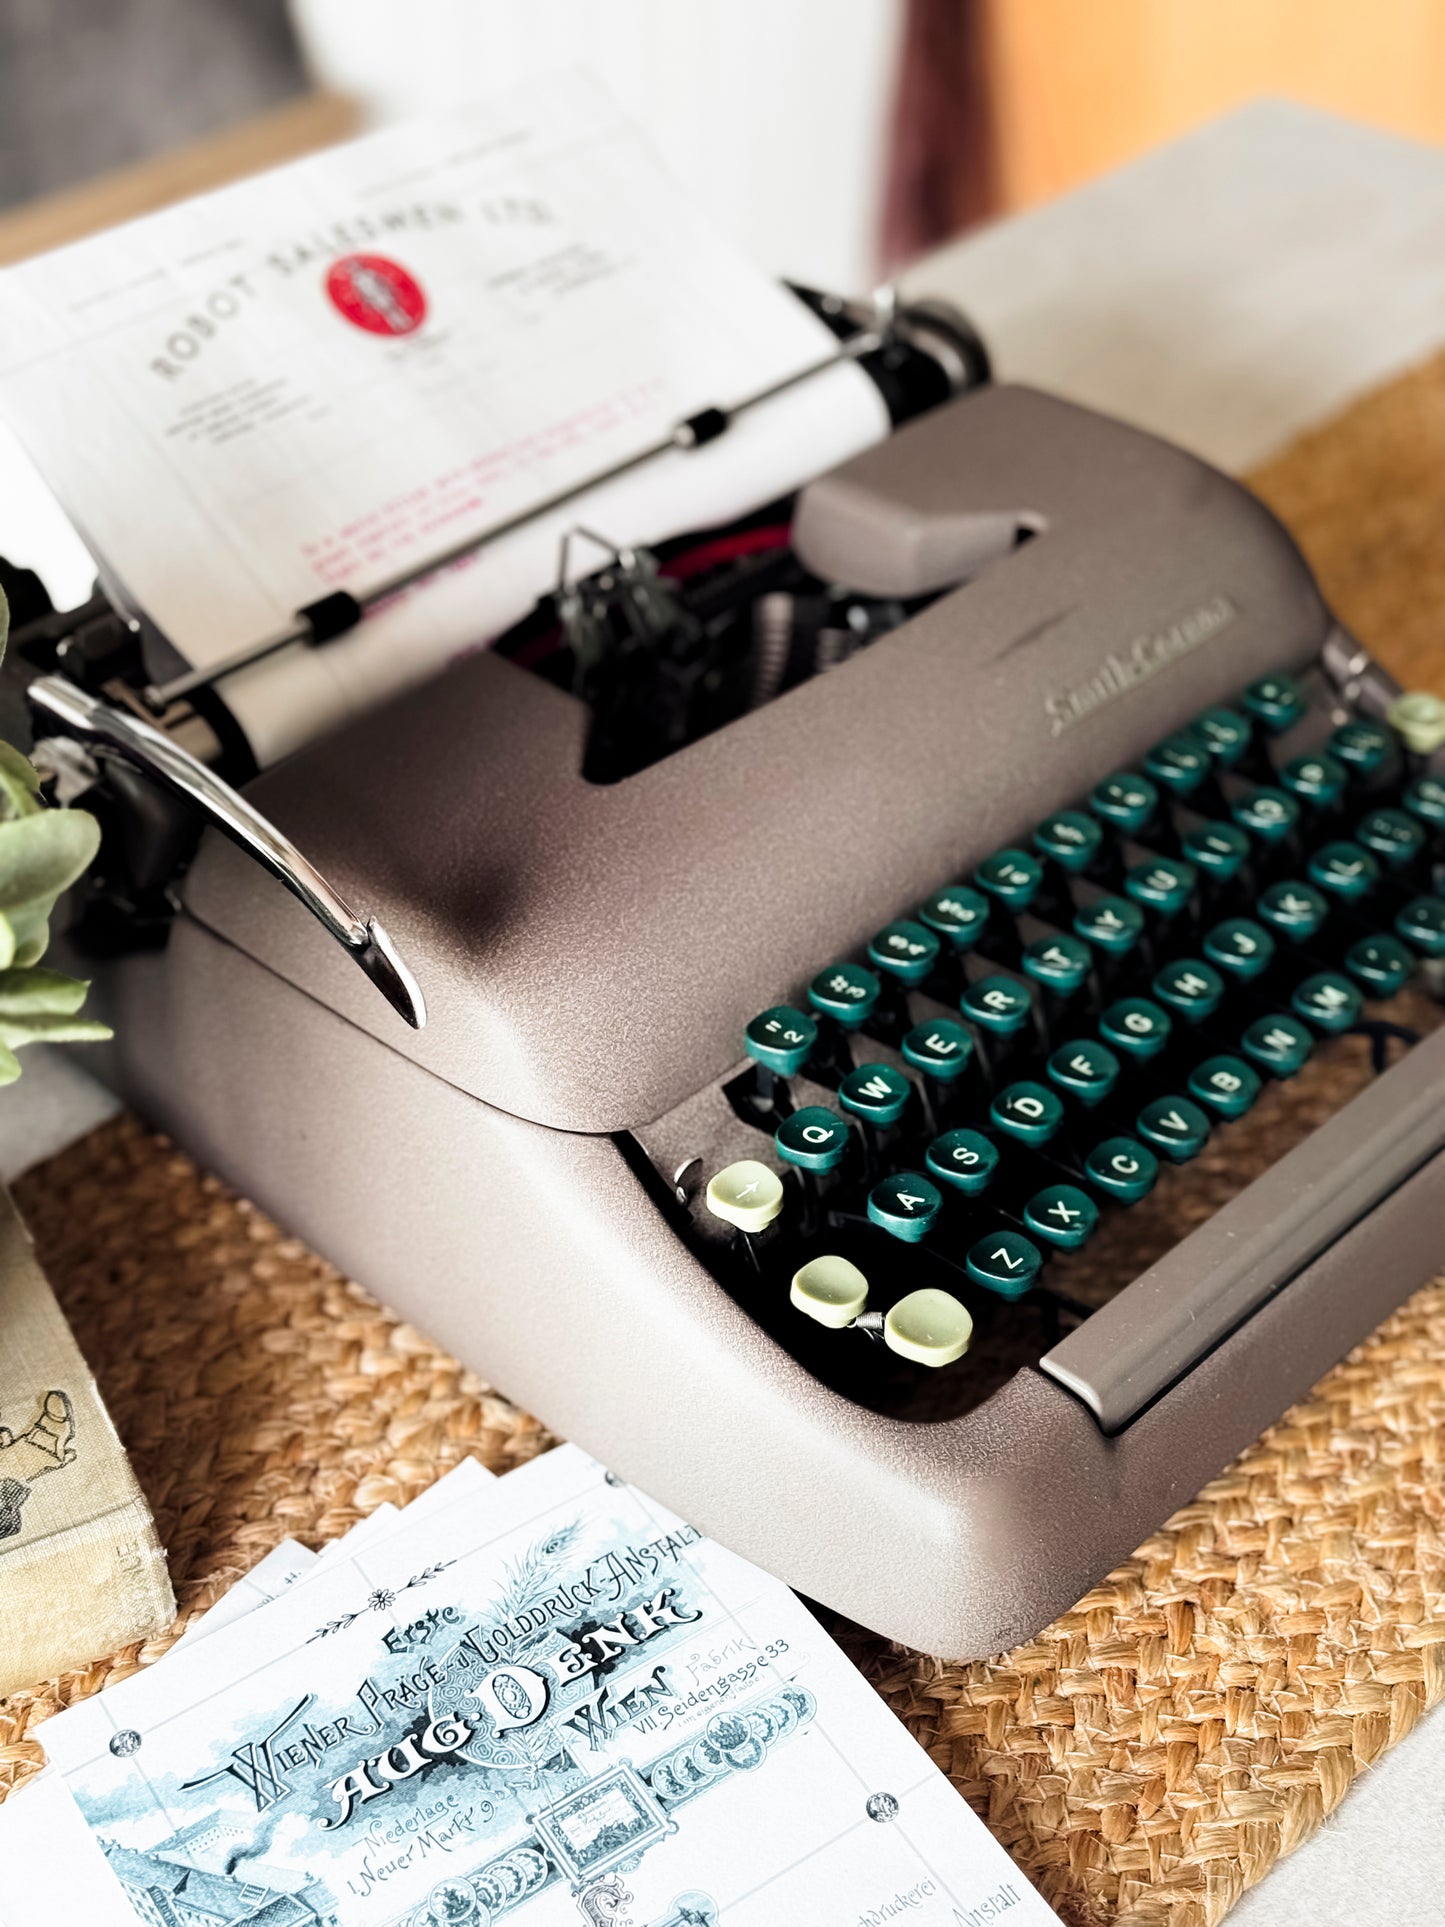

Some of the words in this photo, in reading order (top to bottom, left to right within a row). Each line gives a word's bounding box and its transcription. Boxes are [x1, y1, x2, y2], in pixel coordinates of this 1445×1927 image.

[150, 272, 257, 383] ROBOT
[1174, 973, 1208, 996] H
[983, 990, 1015, 1010] R
[1124, 1013, 1153, 1033] G
[925, 1033, 957, 1055] E
[1069, 1054, 1094, 1076] F
[858, 1075, 892, 1099] W
[1210, 1071, 1242, 1093] B
[1013, 1097, 1045, 1118] D
[1159, 1110, 1189, 1132] V
[802, 1125, 834, 1144] Q
[952, 1147, 980, 1165] S
[1111, 1154, 1140, 1175] C
[896, 1192, 926, 1210] A
[1047, 1200, 1081, 1223] X
[990, 1247, 1024, 1270] Z
[381, 1606, 461, 1655] Erste
[464, 1588, 703, 1738] DENK
[685, 1637, 757, 1687] Fabrik
[657, 1655, 769, 1731] Seidengasse
[765, 1638, 790, 1659] 33
[563, 1665, 675, 1751] WIEN
[360, 1844, 413, 1897] Neuer
